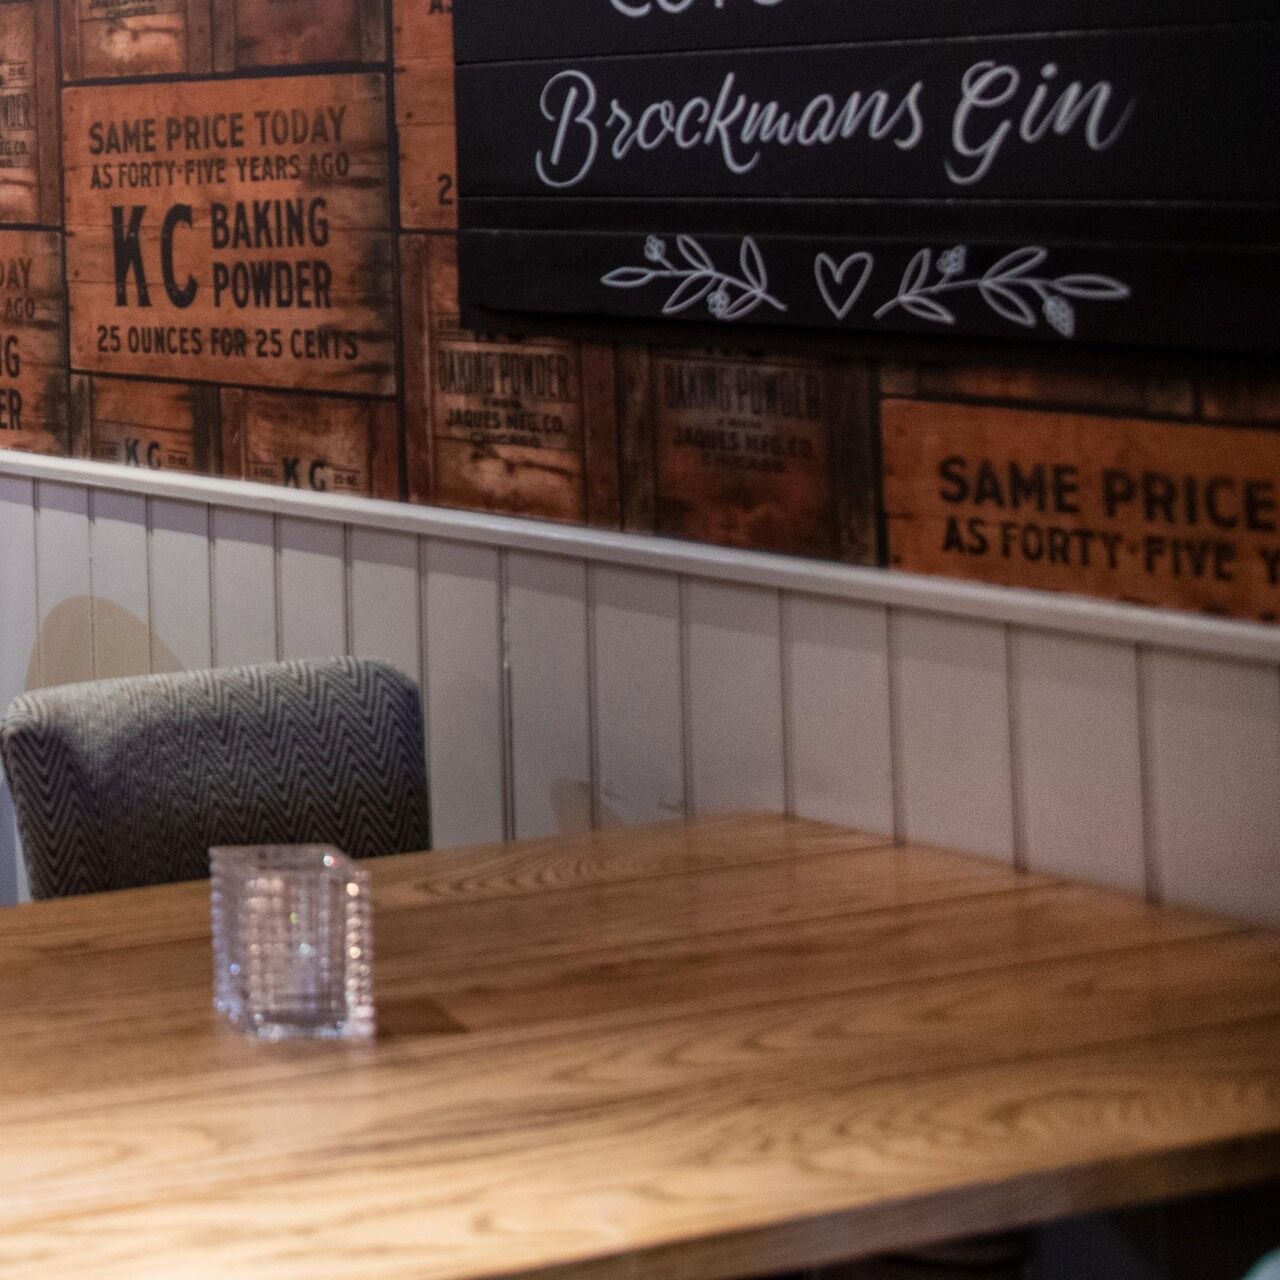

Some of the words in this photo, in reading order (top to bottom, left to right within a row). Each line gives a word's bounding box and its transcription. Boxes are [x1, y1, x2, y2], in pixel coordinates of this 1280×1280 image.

[88, 120, 157, 156] SAME
[165, 114, 245, 152] PRICE
[254, 105, 347, 147] TODAY
[535, 69, 926, 189] Brockmans
[944, 61, 1138, 185] Gin
[90, 163, 113, 191] AS
[236, 154, 301, 183] YEARS
[308, 152, 351, 179] AGO
[209, 196, 330, 250] BAKING
[4, 297, 36, 320] AGO
[212, 260, 332, 310] POWDER
[96, 324, 121, 354] 25
[127, 325, 202, 356] OUNCES
[210, 327, 246, 357] FOR
[255, 328, 282, 358] 25
[290, 329, 359, 360] CENTS
[939, 455, 1082, 515] SAME
[1101, 468, 1279, 534] PRICE
[942, 515, 990, 557] AS
